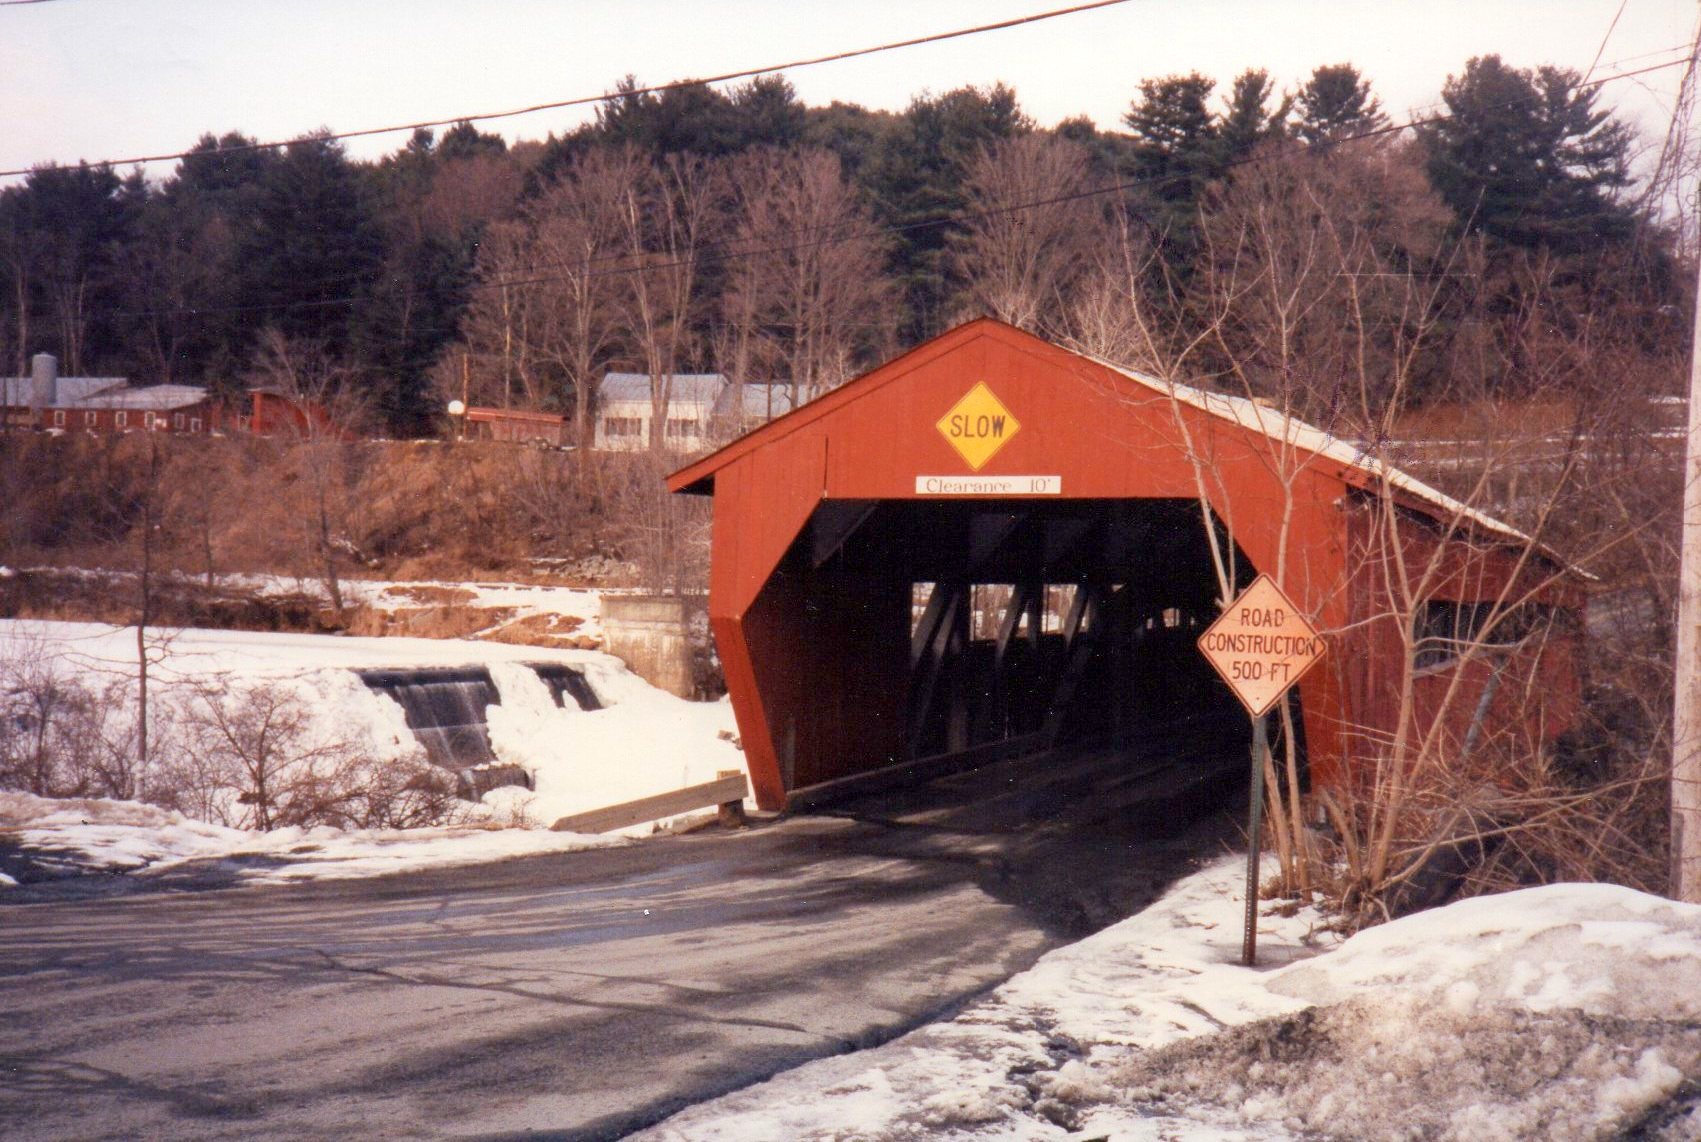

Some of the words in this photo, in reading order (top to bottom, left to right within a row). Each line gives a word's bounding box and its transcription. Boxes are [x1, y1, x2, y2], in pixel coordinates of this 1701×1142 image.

[950, 415, 1006, 438] SLOW
[926, 478, 1012, 493] Clearance
[1241, 608, 1284, 627] ROAD
[1207, 633, 1316, 656] CONSTRUCTION
[1232, 661, 1262, 680] 500
[1270, 663, 1291, 682] FT
